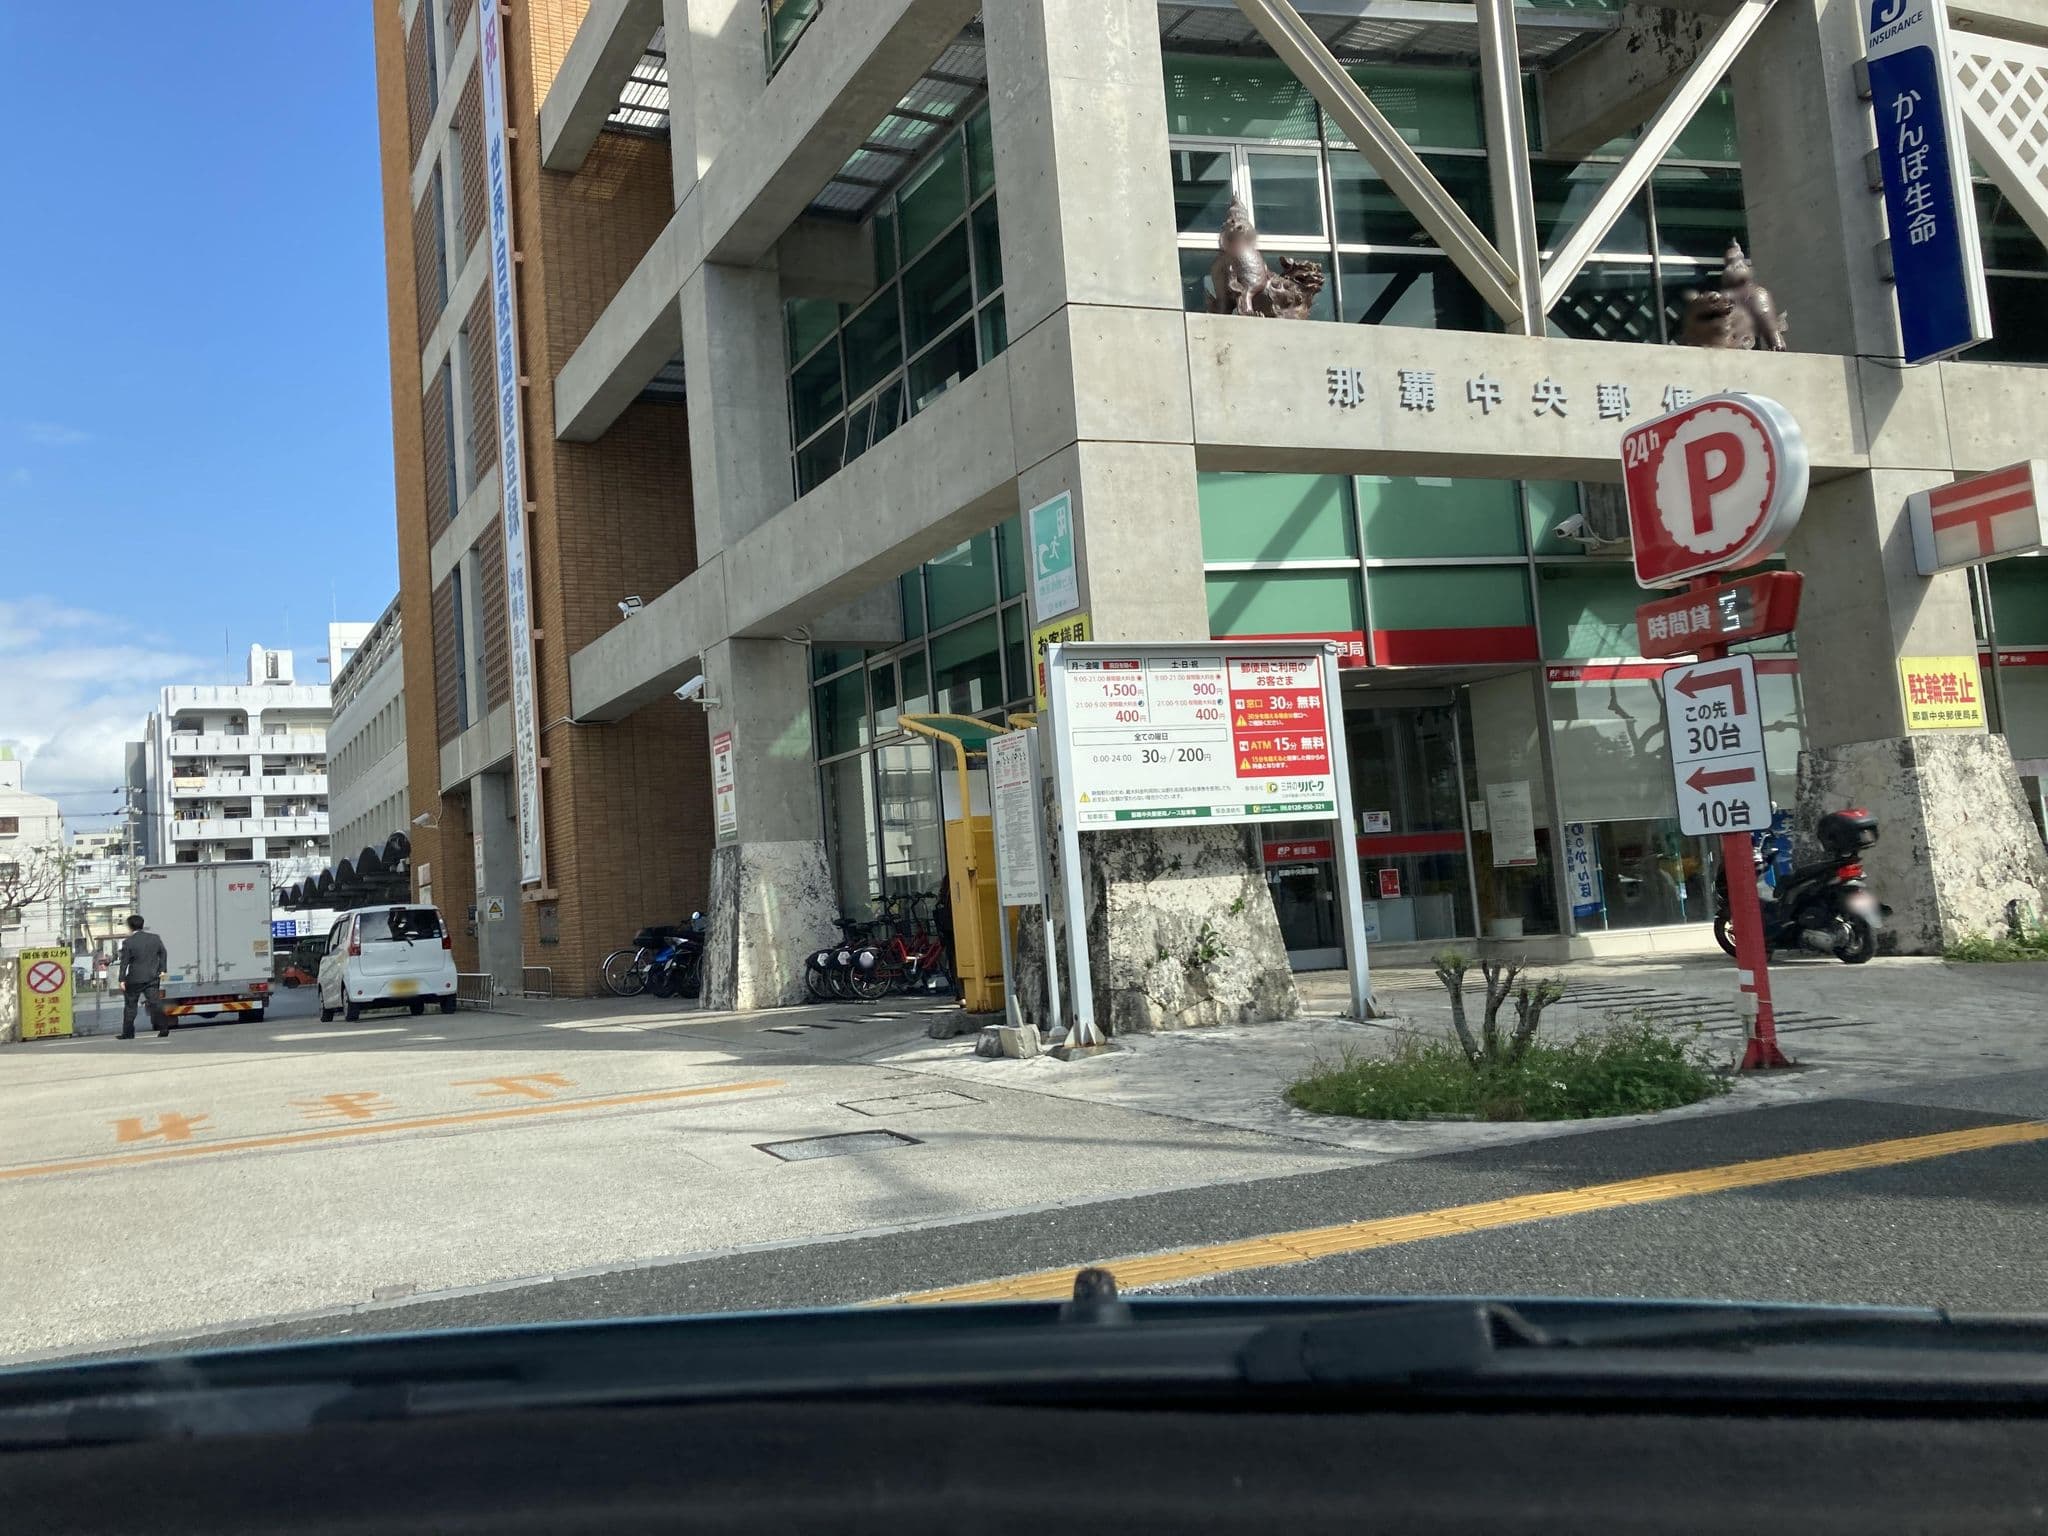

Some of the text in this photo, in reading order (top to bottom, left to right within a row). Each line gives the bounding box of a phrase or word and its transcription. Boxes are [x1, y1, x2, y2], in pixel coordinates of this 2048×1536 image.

[1869, 10, 1924, 49] INSURANCE
[1892, 88, 1936, 245] かんぽ生命
[1328, 366, 1728, 420] 那覇中央郵便
[1625, 430, 1660, 468] 24h
[1684, 431, 1745, 536] P
[1647, 604, 1711, 640] 時間貸
[1241, 663, 1307, 673] 郵便局ご利用の
[1256, 676, 1294, 686] お客さま
[1908, 672, 1976, 704] 駐輪禁止
[1193, 683, 1223, 696] 900円
[1269, 696, 1293, 710] 30分
[1296, 695, 1321, 709] 無料
[1115, 710, 1147, 723] 400円
[1195, 708, 1226, 721] 400円
[1685, 701, 1727, 722] この先
[1912, 710, 1979, 721] 那覇中央郵便局長
[1134, 732, 1169, 741] 全ての曜日
[1250, 736, 1325, 751] ATM 15分 無料
[1687, 723, 1741, 754] 30台
[1281, 781, 1324, 792] 三井のリパーク
[1697, 799, 1750, 828] 10台
[22, 950, 68, 960] 関係者以外
